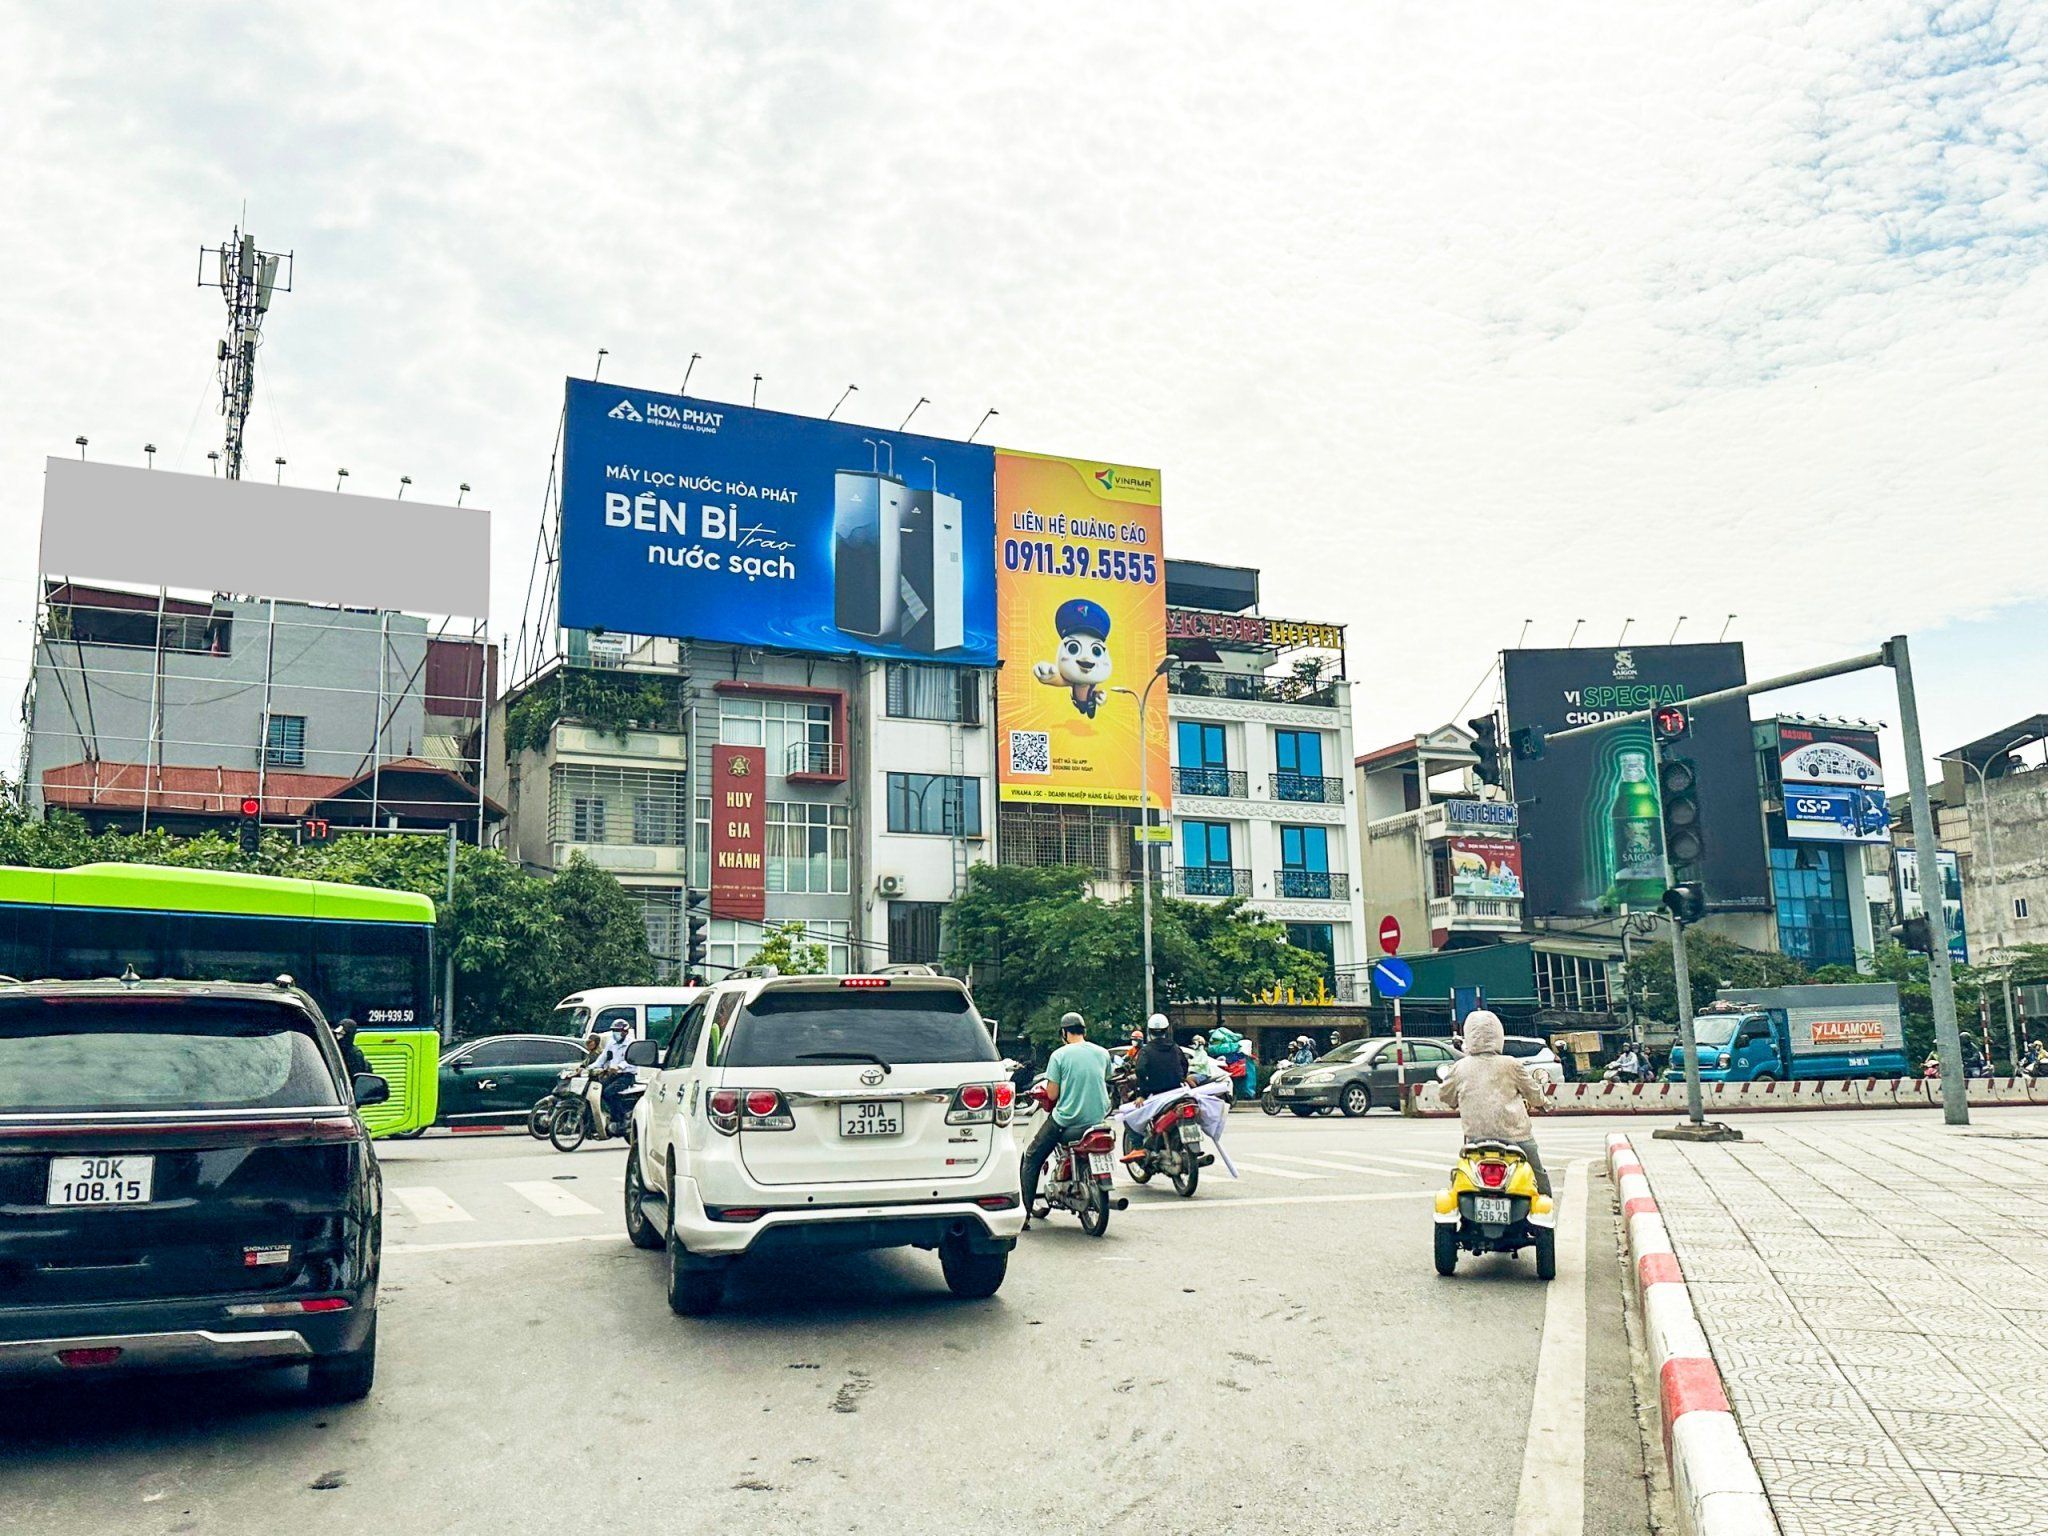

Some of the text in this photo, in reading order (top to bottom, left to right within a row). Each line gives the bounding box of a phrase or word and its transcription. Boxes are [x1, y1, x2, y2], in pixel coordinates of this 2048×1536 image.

[606, 465, 798, 504] MÁY LỌC NƯỚC HÒA PHÁT
[1115, 477, 1151, 488] VINAMA
[605, 491, 796, 551] BỀN BỈ trao
[1013, 510, 1146, 543] LIÊN HỆ QUẢNG CÁO
[648, 544, 795, 582] nước sạch
[1004, 539, 1157, 584] 0911.39.5555
[1166, 608, 1344, 650] VICTORY HOTEL
[1564, 691, 1581, 707] VỊ
[1566, 711, 1601, 725] CHO
[1660, 713, 1685, 732] 77
[726, 791, 753, 809] HUY
[1048, 790, 1066, 798] DOANH
[1449, 801, 1515, 824] VIETCHEM
[306, 821, 327, 838] 77
[728, 821, 751, 839] GIA
[718, 849, 761, 869] KHÁNH
[368, 1009, 414, 1022] 29H-939.50
[1823, 1022, 1881, 1035] LALAMOVE
[858, 1103, 885, 1119] 30A
[847, 1118, 897, 1134] 231.55
[80, 1159, 124, 1179] 30K
[64, 1181, 141, 1202] 108.15
[1477, 1211, 1509, 1223] 596.29
[243, 1244, 292, 1252] SIGNATURE
